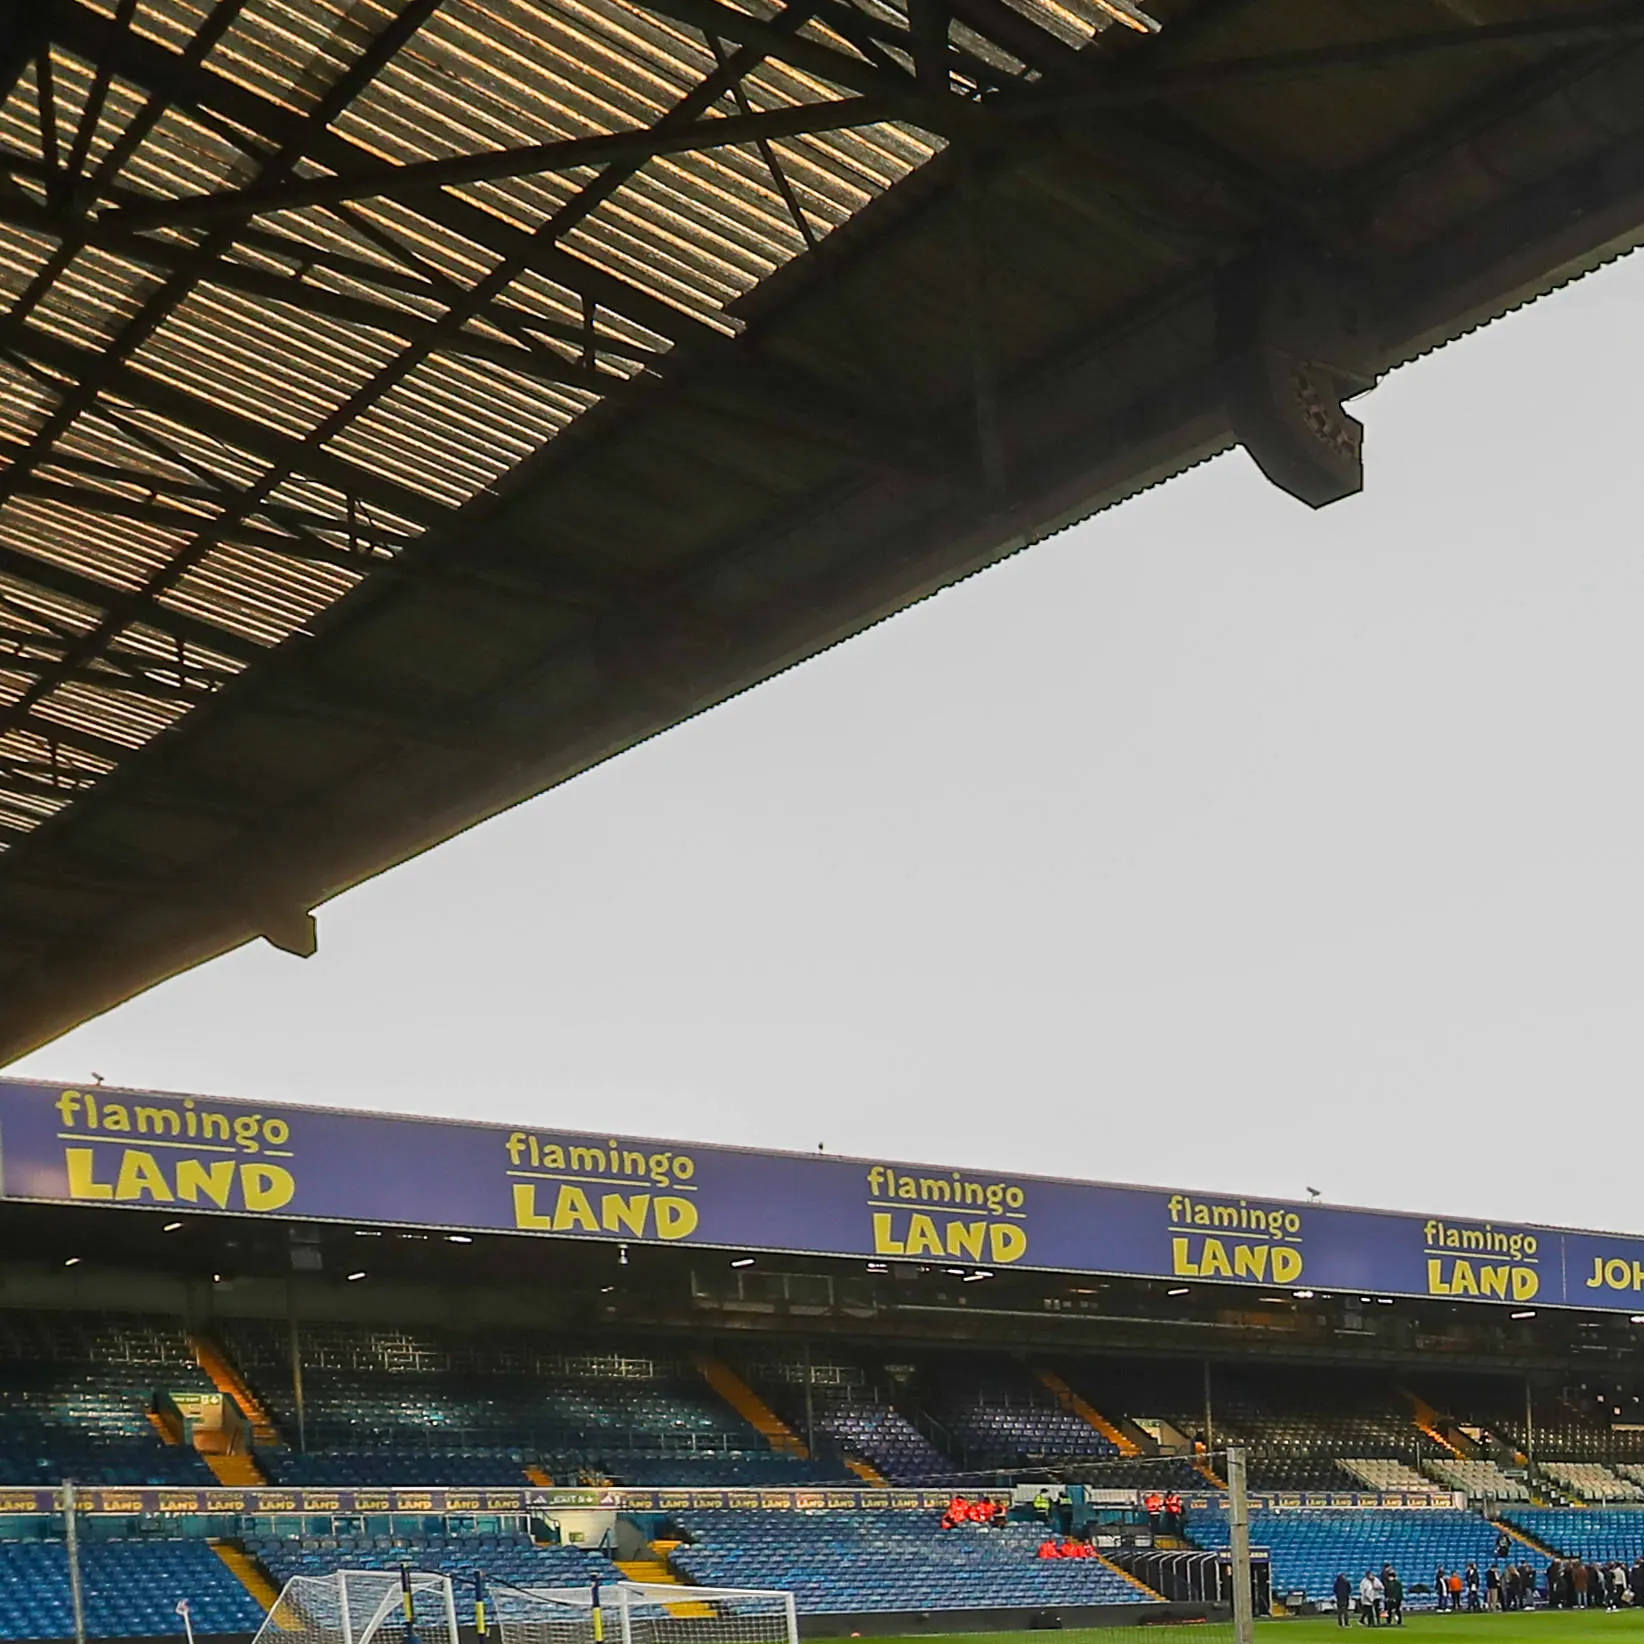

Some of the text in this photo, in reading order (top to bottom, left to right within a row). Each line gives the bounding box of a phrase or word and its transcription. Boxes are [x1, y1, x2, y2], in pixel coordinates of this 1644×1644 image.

[55, 1090, 290, 1153] flamingo
[65, 1147, 296, 1212] LAND
[505, 1132, 695, 1188] flamingo
[513, 1184, 698, 1240] LAND
[867, 1165, 1024, 1216] flamingo
[873, 1212, 1027, 1263] LAND
[1168, 1194, 1300, 1240] flamingo
[1424, 1219, 1537, 1261] flamingo
[1172, 1237, 1303, 1284] LAND
[1428, 1258, 1539, 1301] LAND
